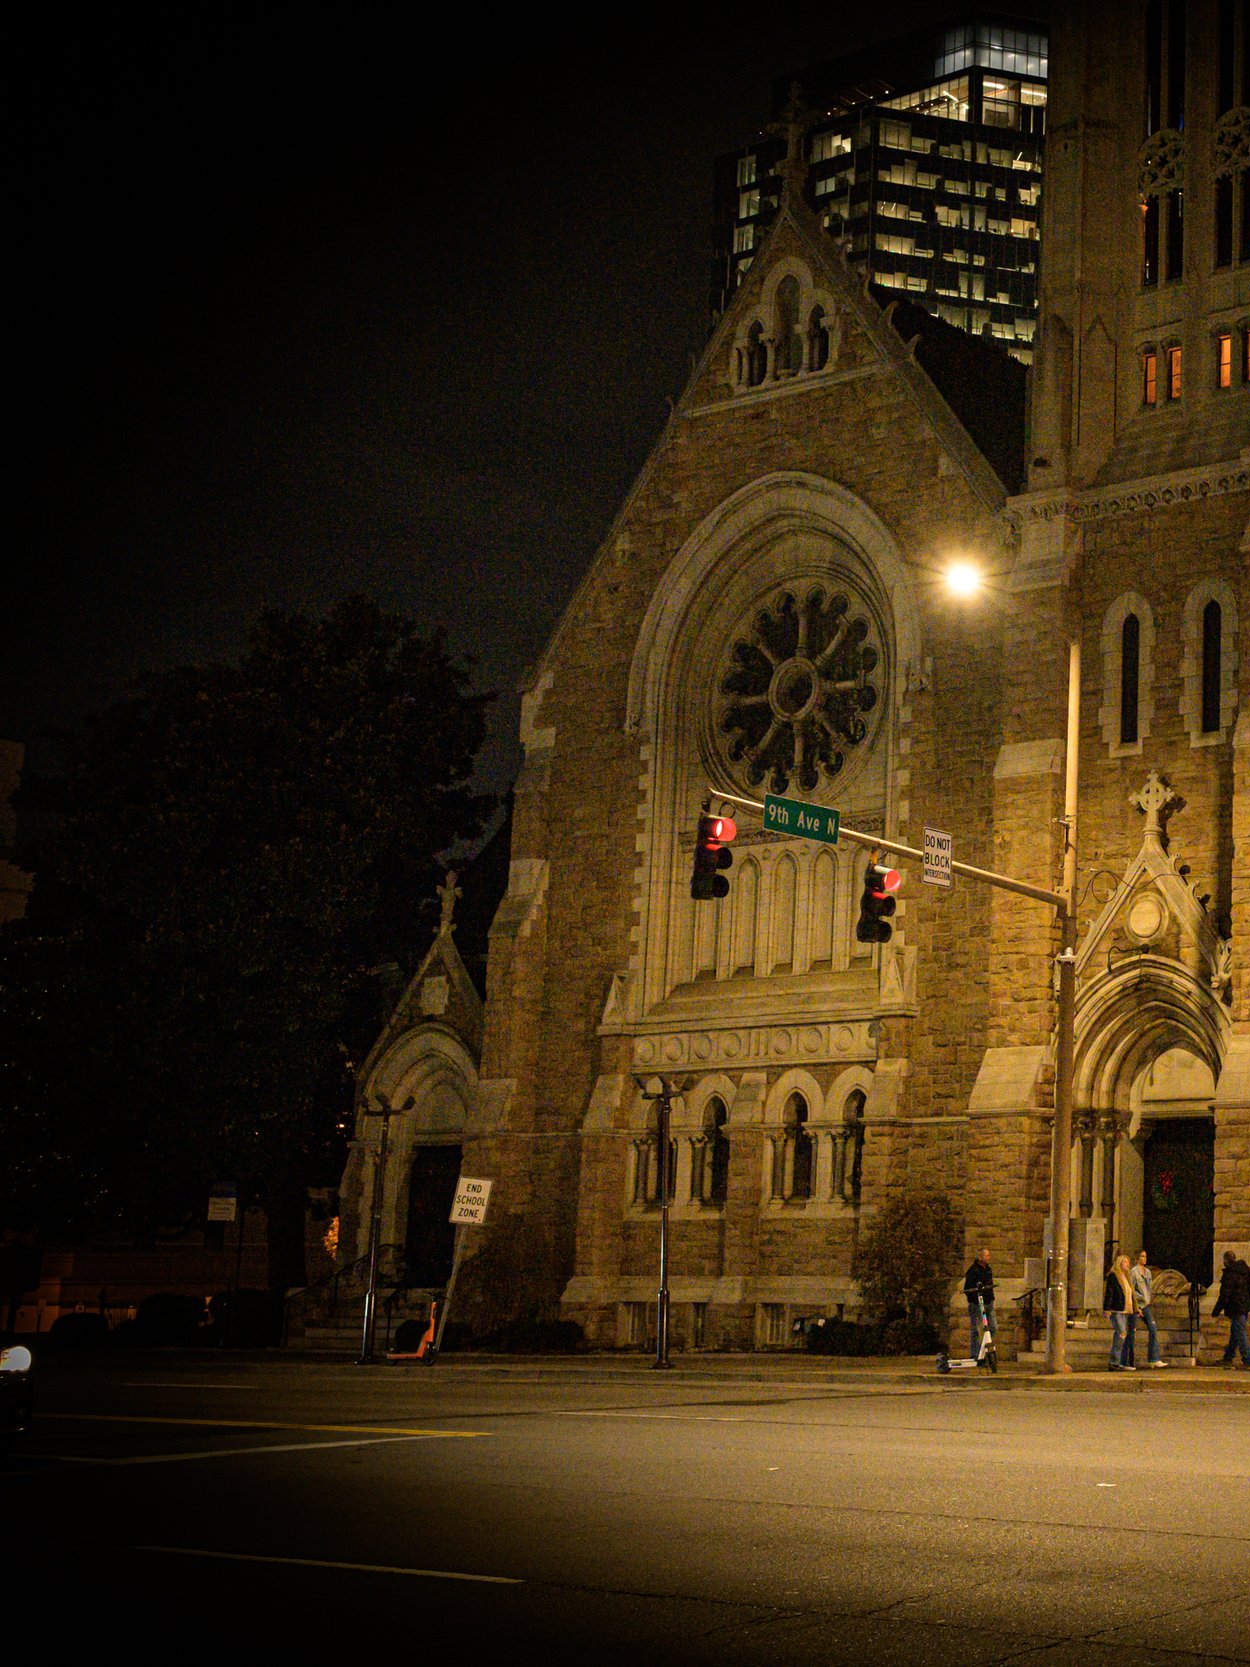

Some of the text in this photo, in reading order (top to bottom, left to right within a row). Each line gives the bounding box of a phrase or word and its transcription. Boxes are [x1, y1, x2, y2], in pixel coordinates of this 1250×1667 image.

[768, 804, 836, 835] 9th Ave N
[925, 834, 950, 851] DO NOT
[925, 852, 950, 869] BLOCK
[466, 1183, 482, 1193] END
[456, 1194, 486, 1207] SCHOOL
[458, 1207, 480, 1218] ZONE
